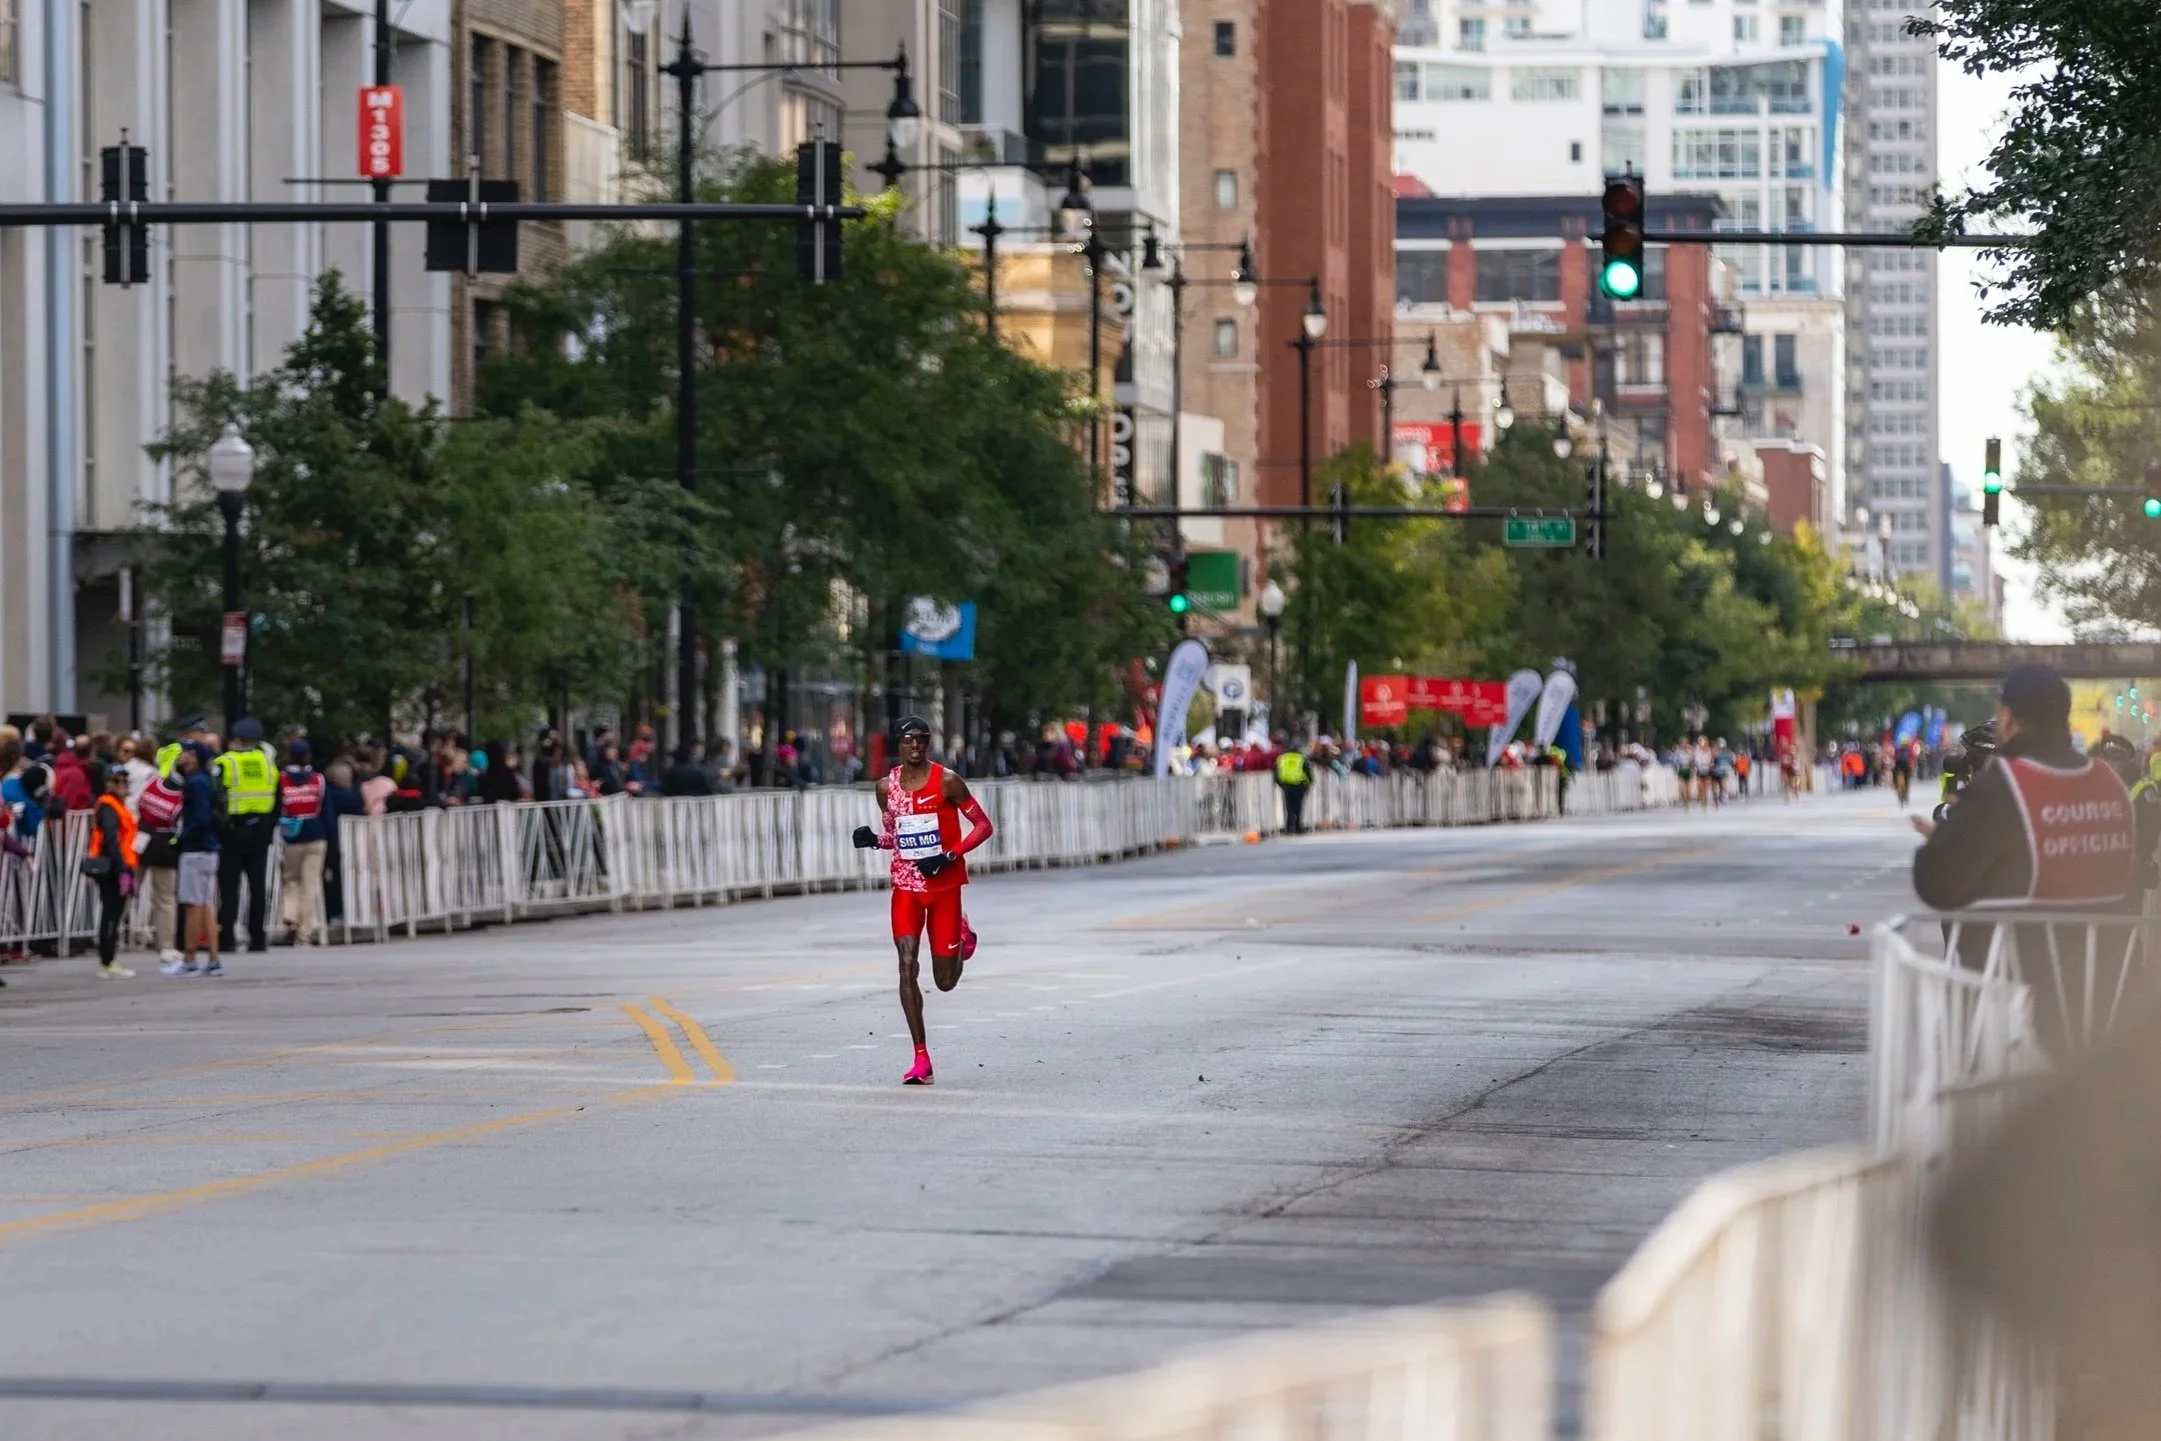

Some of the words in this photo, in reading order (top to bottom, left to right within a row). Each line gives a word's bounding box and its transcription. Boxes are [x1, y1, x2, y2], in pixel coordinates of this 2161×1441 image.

[2041, 801, 2123, 825] COURSE
[900, 836, 917, 848] SIR
[918, 833, 937, 846] MO
[2043, 832, 2129, 856] OFFICIAL
